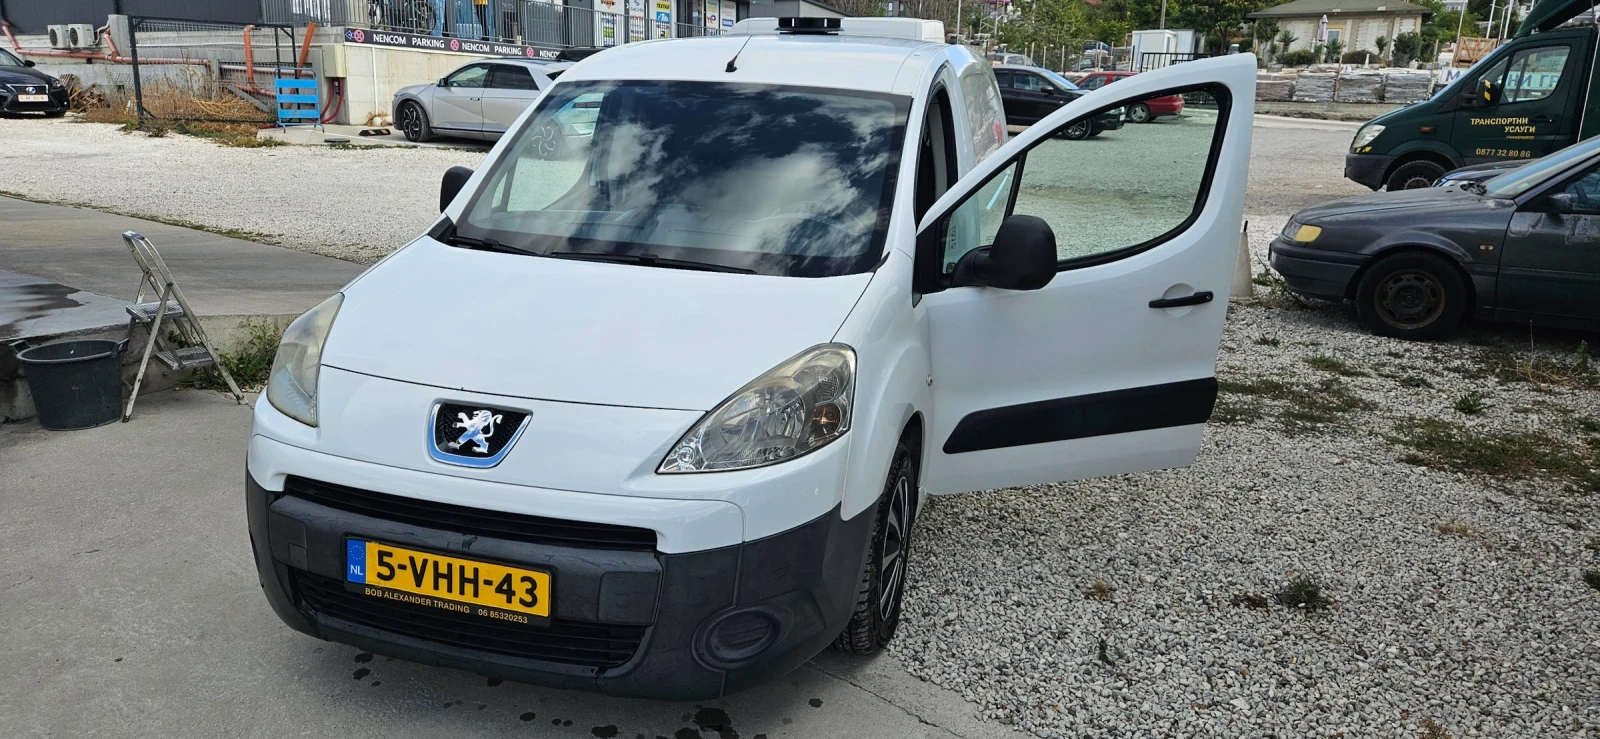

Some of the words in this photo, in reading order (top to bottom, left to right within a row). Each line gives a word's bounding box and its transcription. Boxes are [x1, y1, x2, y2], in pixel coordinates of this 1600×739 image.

[373, 34, 406, 44] NENCOM
[412, 38, 444, 48] PARKING
[462, 43, 489, 52] NENCOM
[494, 46, 521, 55] PARKING
[1471, 117, 1528, 125] ТРАНСПОРТНИ
[1476, 148, 1495, 156] 0877
[1497, 149, 1507, 157] 32
[350, 564, 364, 575] NL
[377, 550, 538, 608] 5-VHH-43
[365, 587, 382, 597] BOB
[384, 591, 432, 606] ALEXANDER
[433, 599, 470, 614] TRADING
[478, 608, 488, 617] 06
[489, 611, 528, 624] 85320253
